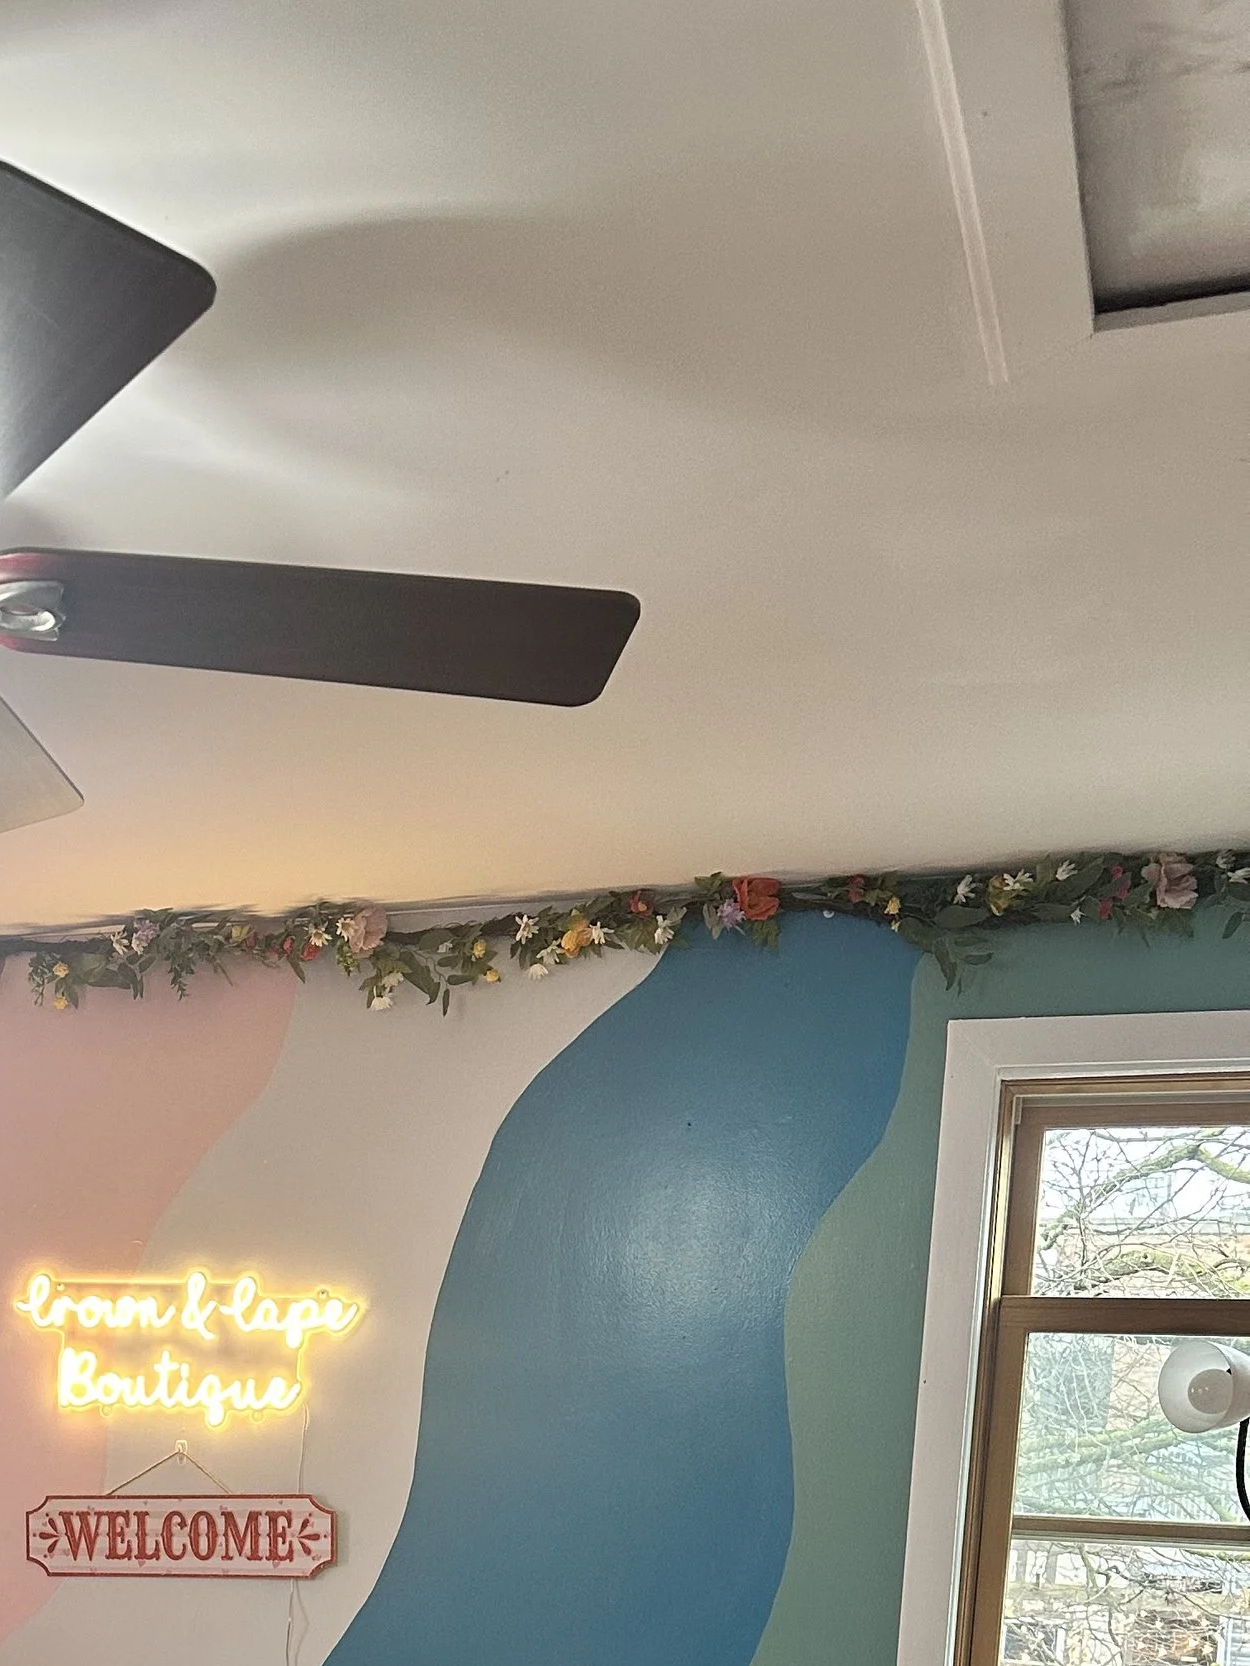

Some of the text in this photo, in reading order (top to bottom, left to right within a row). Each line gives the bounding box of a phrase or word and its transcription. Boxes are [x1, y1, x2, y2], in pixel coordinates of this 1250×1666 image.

[182, 1272, 217, 1340] &
[59, 1347, 301, 1426] Boutique
[58, 1510, 294, 1562] WELCOME
